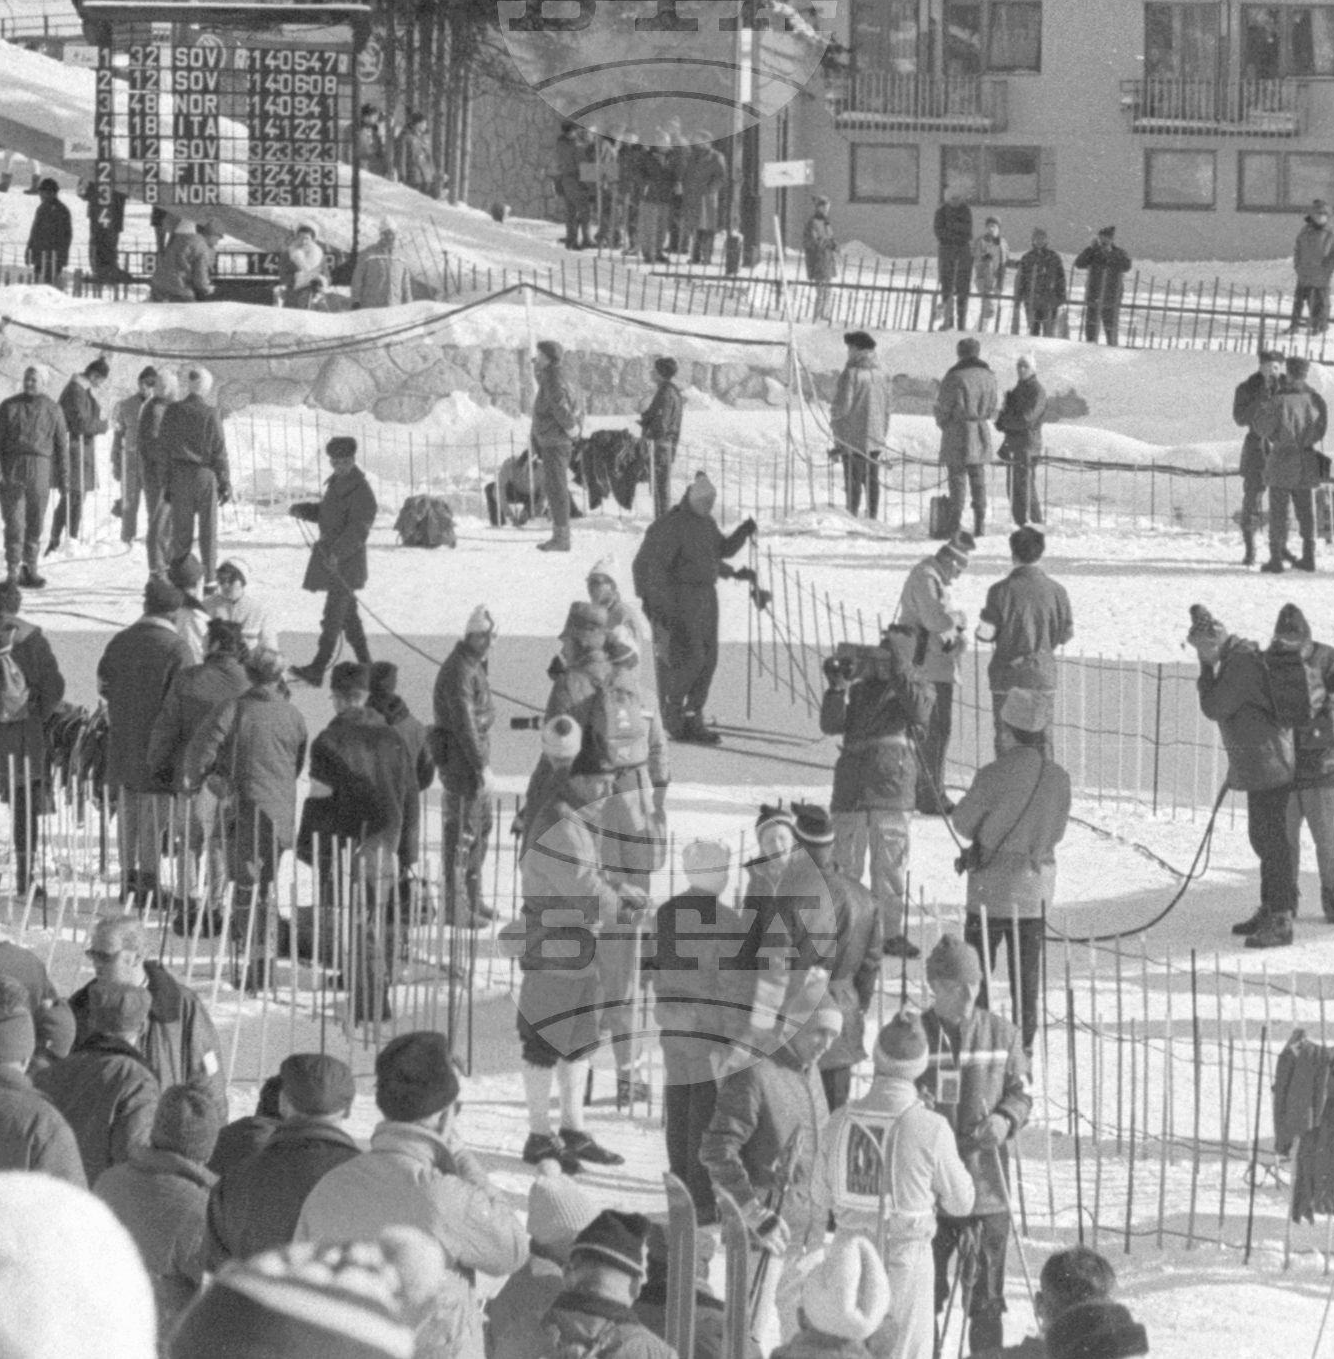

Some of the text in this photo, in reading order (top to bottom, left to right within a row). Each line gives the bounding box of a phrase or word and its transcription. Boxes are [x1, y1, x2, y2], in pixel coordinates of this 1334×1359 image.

[101, 48, 110, 66] 1
[131, 46, 158, 66] 32
[175, 47, 218, 67] SOV
[99, 70, 111, 90] 2
[133, 70, 158, 90] 12
[175, 71, 218, 91] SOV
[99, 93, 110, 113] 3
[131, 93, 157, 113] 48
[175, 94, 217, 114] NOR
[99, 116, 110, 136] 4
[133, 115, 157, 135] 18
[179, 116, 217, 137] ITA
[102, 140, 109, 158] 1
[133, 139, 158, 158] 12
[175, 139, 217, 159] SOV
[99, 162, 110, 182] 2
[145, 163, 157, 182] 2
[175, 163, 217, 183] FIN
[99, 184, 110, 205] 3
[145, 184, 158, 203] 8
[175, 184, 217, 204] NOR
[98, 208, 111, 228] 4
